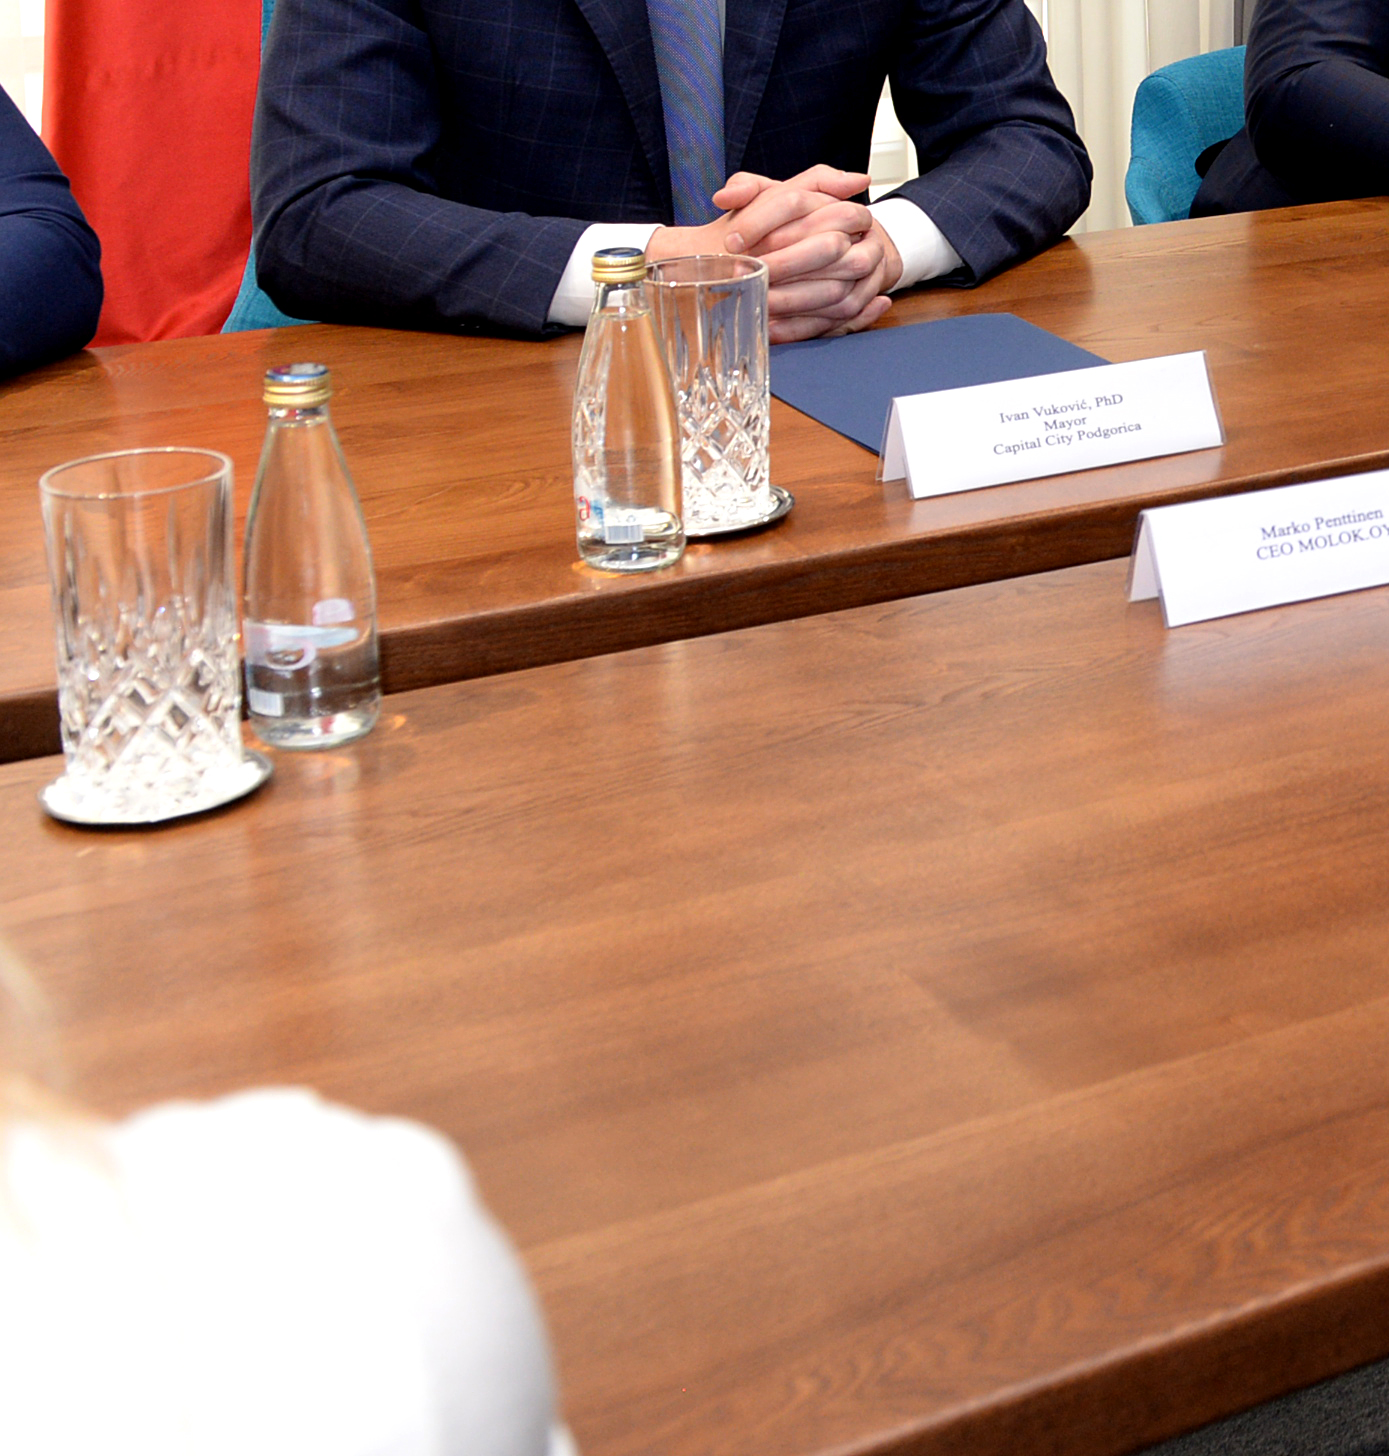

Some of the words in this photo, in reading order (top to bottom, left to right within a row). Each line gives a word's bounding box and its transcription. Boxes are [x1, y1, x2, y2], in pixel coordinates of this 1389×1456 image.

[999, 411, 1030, 424] Ivan
[1032, 399, 1092, 417] Vuković,
[1094, 393, 1124, 408] PhD
[1043, 416, 1088, 431] Mayor
[993, 437, 1042, 455] Capital
[1045, 434, 1074, 446] City
[1076, 422, 1142, 441] Podgorica
[1260, 521, 1310, 540] Marko
[1314, 509, 1384, 530] Penttinen
[1256, 542, 1294, 560] CEO
